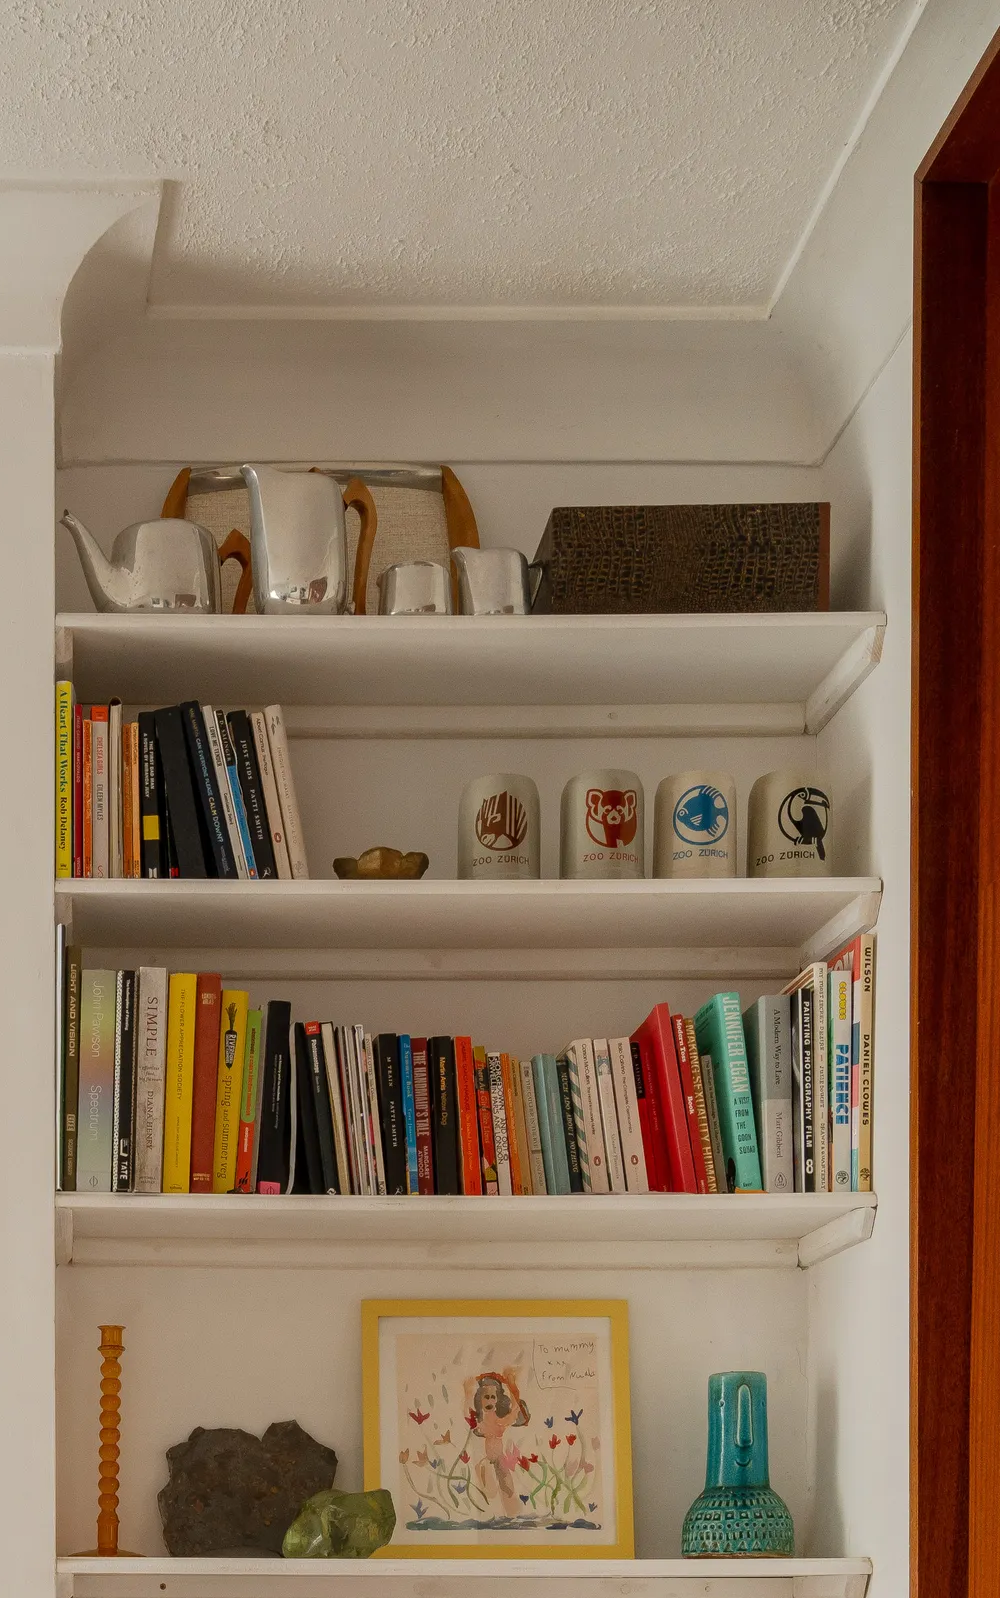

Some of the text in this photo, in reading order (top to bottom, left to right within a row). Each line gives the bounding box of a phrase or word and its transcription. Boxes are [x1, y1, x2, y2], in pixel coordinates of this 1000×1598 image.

[211, 739, 218, 747] ME
[221, 730, 232, 762] SALINGER
[197, 750, 208, 778] EVERYONE
[213, 748, 222, 767] TENDER
[58, 689, 68, 851] A Heart That Works Rob Delaney
[240, 740, 264, 840] JUST KIDS PATTI SMITH
[208, 797, 217, 816] CALM
[212, 816, 223, 842] DOWN?
[472, 855, 530, 867] ZOO ZÜRICH
[583, 852, 639, 864] ZOO ZÜRICH
[672, 849, 729, 861] ZOO ZÜRICH
[755, 850, 815, 867] ZOO ZÜRICH
[838, 981, 847, 1021] CLOWES
[91, 980, 104, 1058] John Pawson
[145, 996, 158, 1057] SIMPLE
[774, 1017, 782, 1044] Modern
[311, 1039, 320, 1074] Photomontage
[617, 1042, 625, 1053] Italo
[723, 997, 749, 1093] JENNIFER EGAN
[772, 1045, 782, 1061] Way
[477, 1063, 485, 1081] There
[494, 1056, 502, 1085] GEORGE
[619, 1054, 627, 1074] Calvino
[676, 1019, 685, 1045] Modern
[687, 1096, 695, 1115] Book
[220, 1076, 233, 1107] spring
[412, 1050, 429, 1136] THE HANDMAID'S TALE
[478, 1082, 486, 1093] Are
[803, 1001, 814, 1174] PAINTING PHOTOGRAPHY FILM 8
[836, 1044, 849, 1125] PATIENCE
[88, 1085, 101, 1141] Spectrum
[440, 1091, 448, 1111] Yellow
[526, 1091, 535, 1116] CATCHER
[685, 1024, 717, 1192] MAKING SEXUALITY HUMAN
[733, 1096, 750, 1106] A VISIT
[862, 1079, 870, 1125] CLOWES
[440, 1112, 448, 1126] Dog
[566, 1112, 574, 1136] ABOUT
[734, 1109, 749, 1118] FROM
[736, 1121, 746, 1130] THE
[146, 1122, 154, 1150] HENRY
[483, 1125, 491, 1144] Lions
[500, 1118, 508, 1134] AND
[737, 1133, 752, 1142] GOON
[220, 1123, 230, 1160] summer
[495, 1131, 504, 1164] LONDON
[739, 1145, 756, 1155] SQUAD
[776, 1131, 784, 1158] Gibberd
[569, 1139, 579, 1172] NOTHING
[120, 1161, 129, 1180] TATE
[217, 1162, 228, 1179] veg
[538, 1342, 594, 1355] To mummy
[542, 1371, 564, 1381] from
